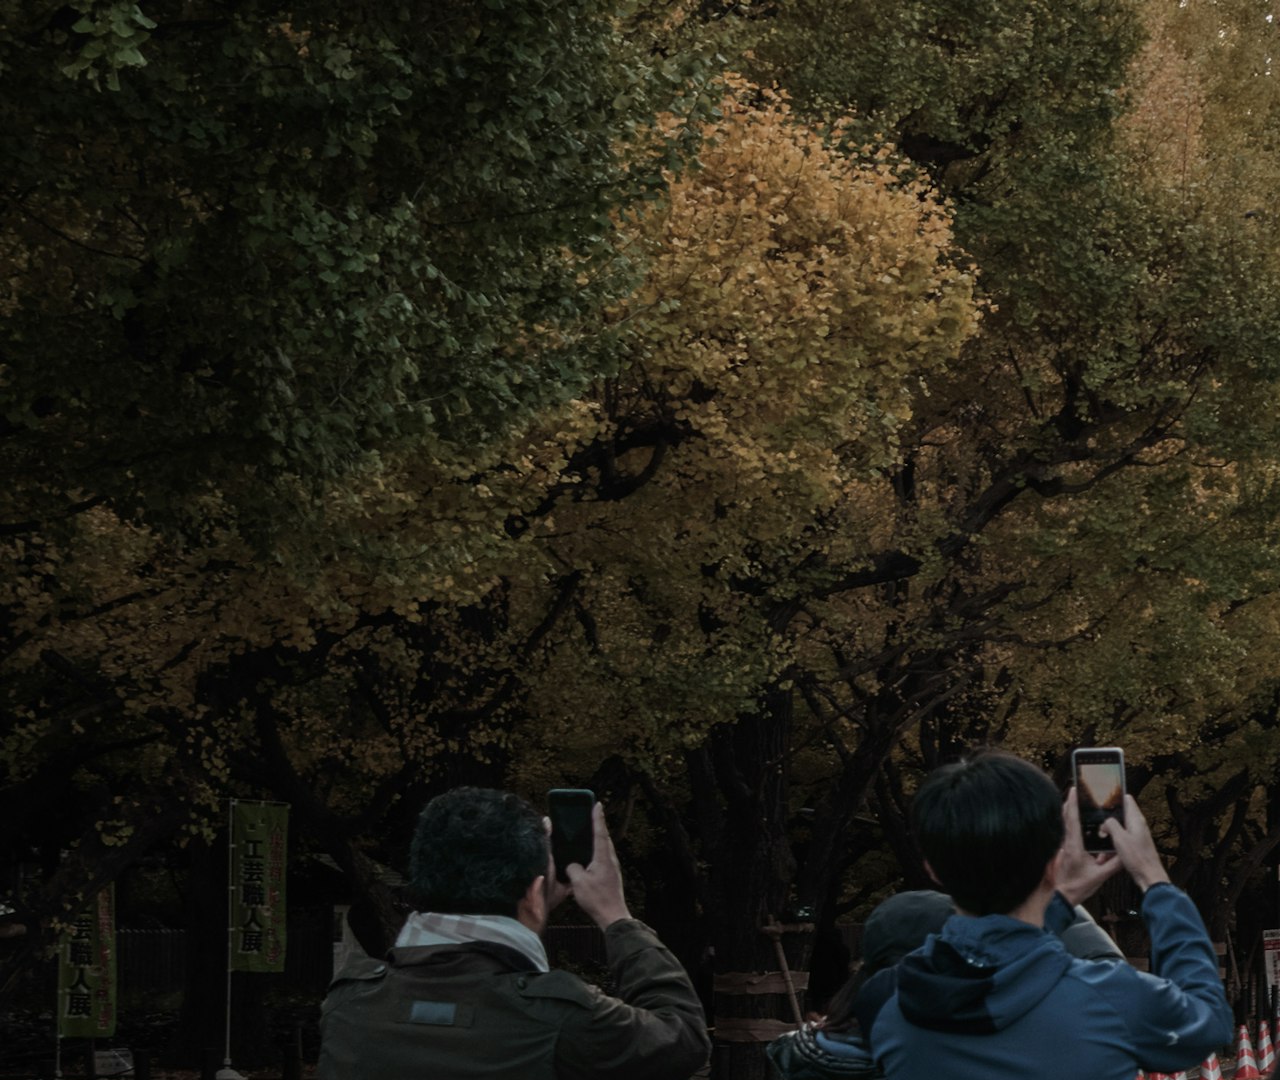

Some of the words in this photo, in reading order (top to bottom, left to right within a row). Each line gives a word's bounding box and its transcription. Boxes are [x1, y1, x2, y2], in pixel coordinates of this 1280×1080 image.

[242, 839, 264, 952] 工芸職人展
